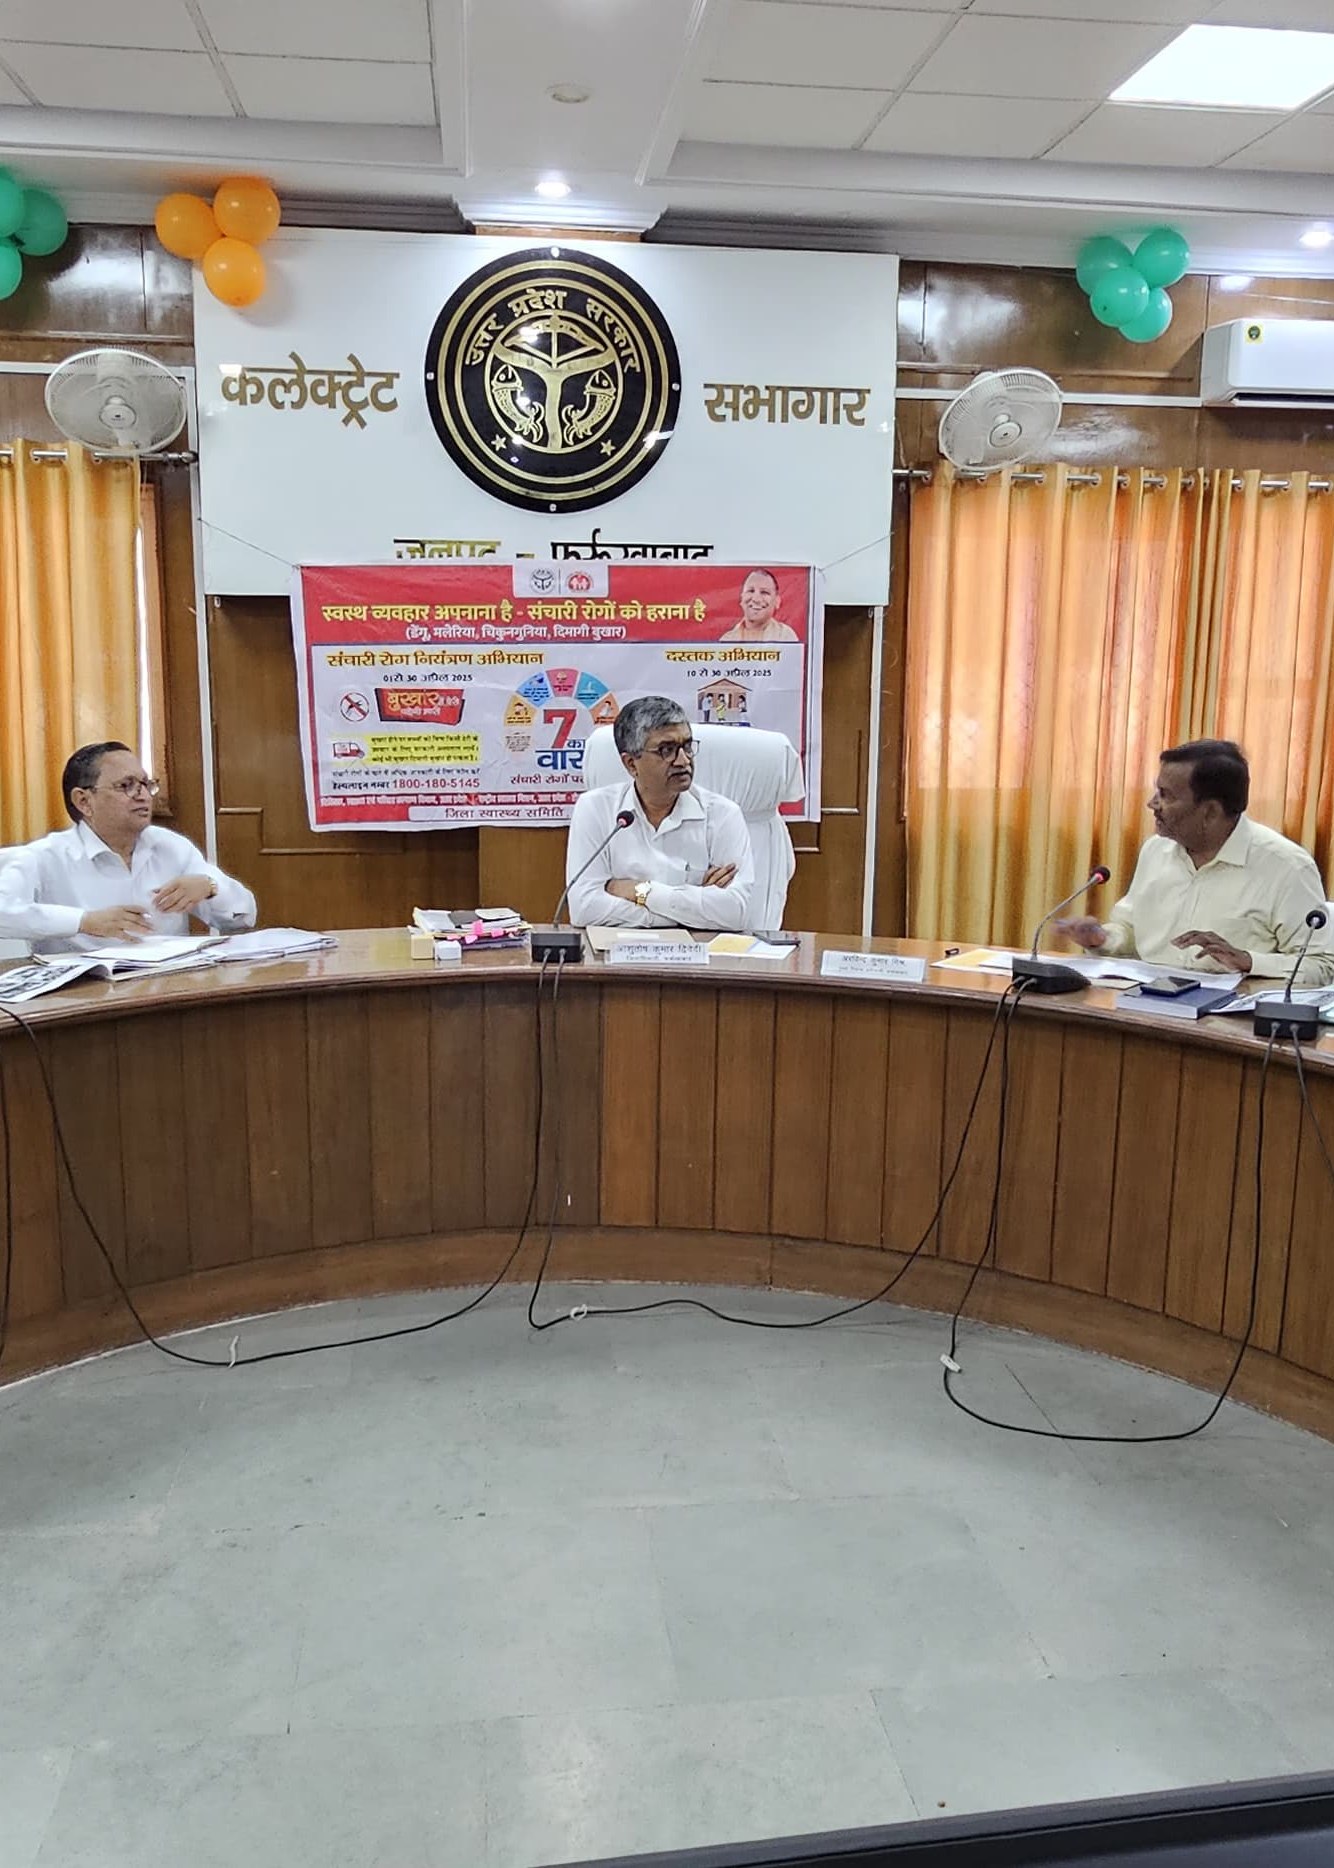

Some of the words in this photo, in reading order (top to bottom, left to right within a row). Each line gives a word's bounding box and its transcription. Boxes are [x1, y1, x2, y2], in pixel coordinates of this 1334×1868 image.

[465, 312, 504, 365] उत्तर
[508, 288, 567, 317] प्रदेश
[586, 298, 641, 373] सरकार
[219, 351, 400, 430] कलेक्ट्रेट
[703, 383, 871, 426] सभागार
[322, 604, 368, 622] स्वस्थ
[371, 604, 430, 623] व्यवहार
[434, 604, 497, 622] अपनाना
[500, 599, 514, 622] है
[527, 600, 578, 621] संचारी
[582, 599, 618, 620] रोगों
[620, 600, 644, 620] को
[646, 603, 691, 622] हराना
[693, 598, 707, 622] है
[553, 623, 589, 638] दिमागी
[326, 651, 375, 666] संचारी
[379, 651, 411, 666] रोग
[414, 650, 473, 665] नियंत्रण
[476, 649, 544, 665] अभियान
[665, 650, 716, 662] दस्तक
[718, 648, 781, 662] अभियान
[407, 674, 417, 682] 30
[452, 674, 473, 682] 2025
[712, 669, 721, 677] 30
[753, 669, 772, 677] 2025
[543, 709, 577, 749] 7
[393, 777, 480, 789] 1800-180-5145
[445, 807, 473, 818] जिला
